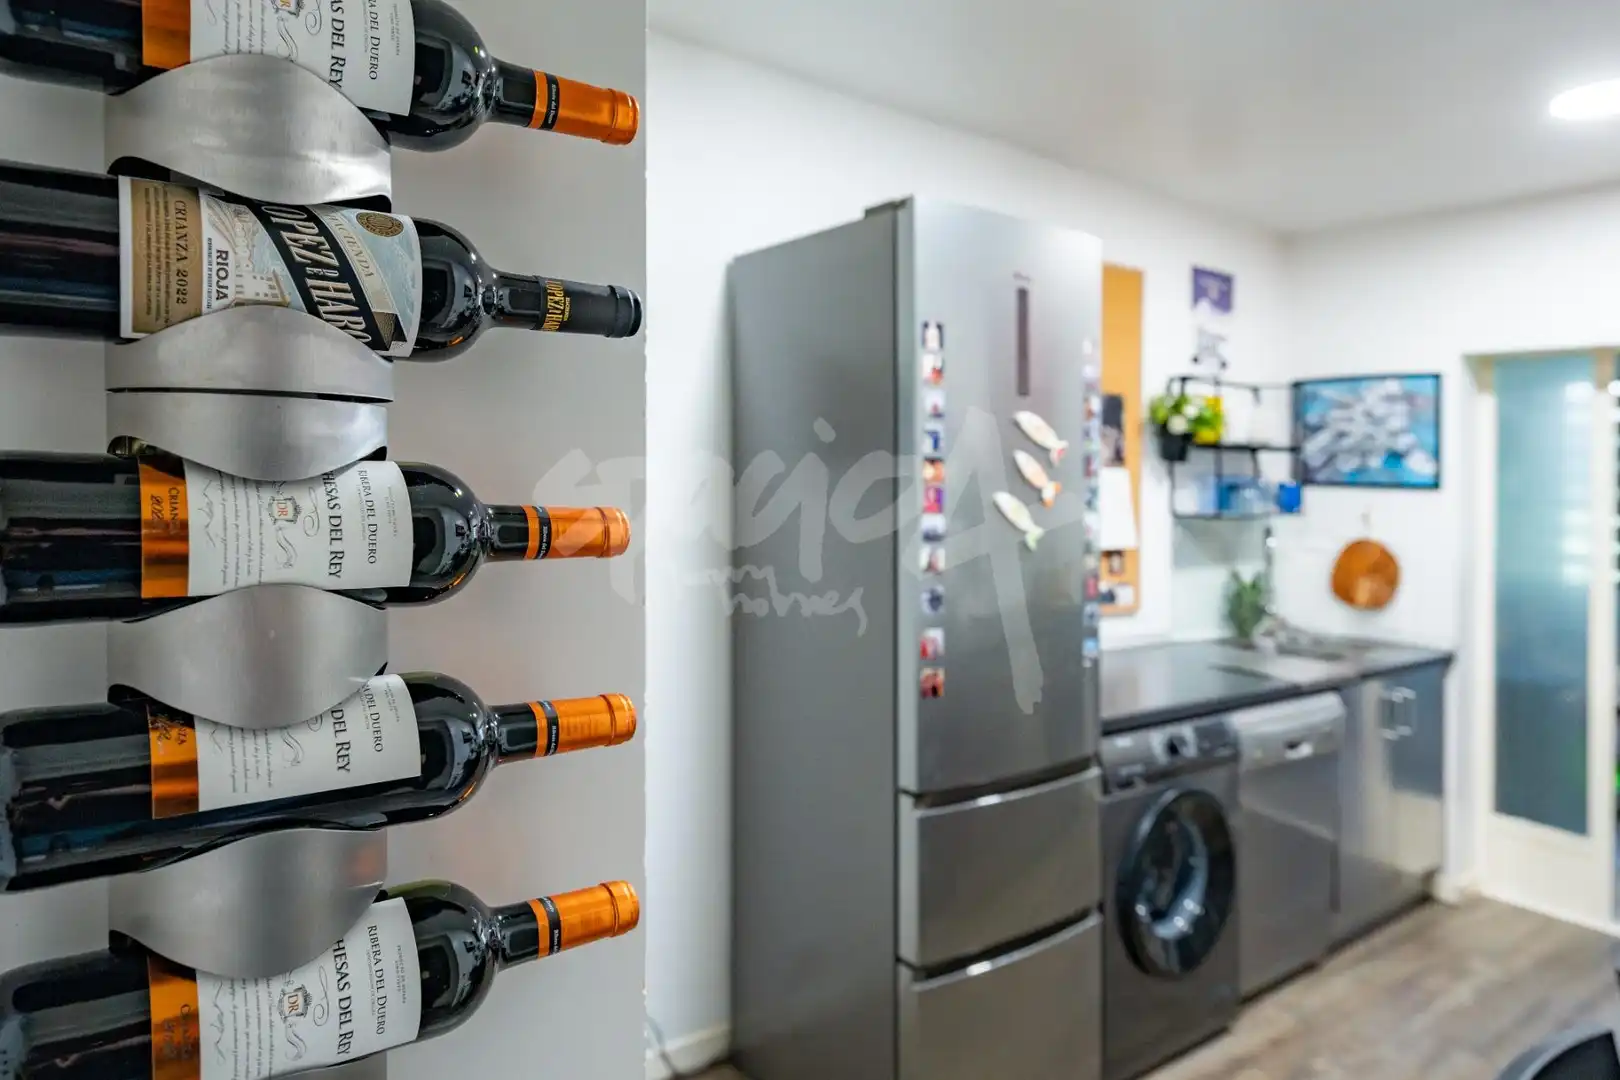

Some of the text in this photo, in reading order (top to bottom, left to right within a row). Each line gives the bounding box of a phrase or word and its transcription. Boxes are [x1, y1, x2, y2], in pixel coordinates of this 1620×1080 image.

[331, 17, 344, 50] DEL
[369, 11, 379, 31] DEL
[328, 55, 346, 89] REY
[368, 36, 380, 80] DUERO
[174, 200, 190, 306] CRIANZA 2022
[324, 212, 374, 278] HACIENDA
[214, 249, 230, 302] RIOJA
[260, 205, 340, 268] OPEZ
[302, 277, 372, 342] HARO
[357, 469, 372, 497] RIBERA
[276, 502, 290, 517] DR
[366, 500, 375, 520] DEL
[328, 514, 344, 546] DEL
[367, 523, 378, 564] DUERO
[327, 551, 346, 579] REY
[364, 693, 376, 709] DEL
[370, 712, 383, 752] DUERO
[330, 708, 352, 773] DEL REY
[367, 925, 387, 1035] RIBERA DEL DUERO
[286, 993, 301, 1014] DR
[339, 996, 353, 1030] DEL
[337, 1031, 354, 1055] REY
